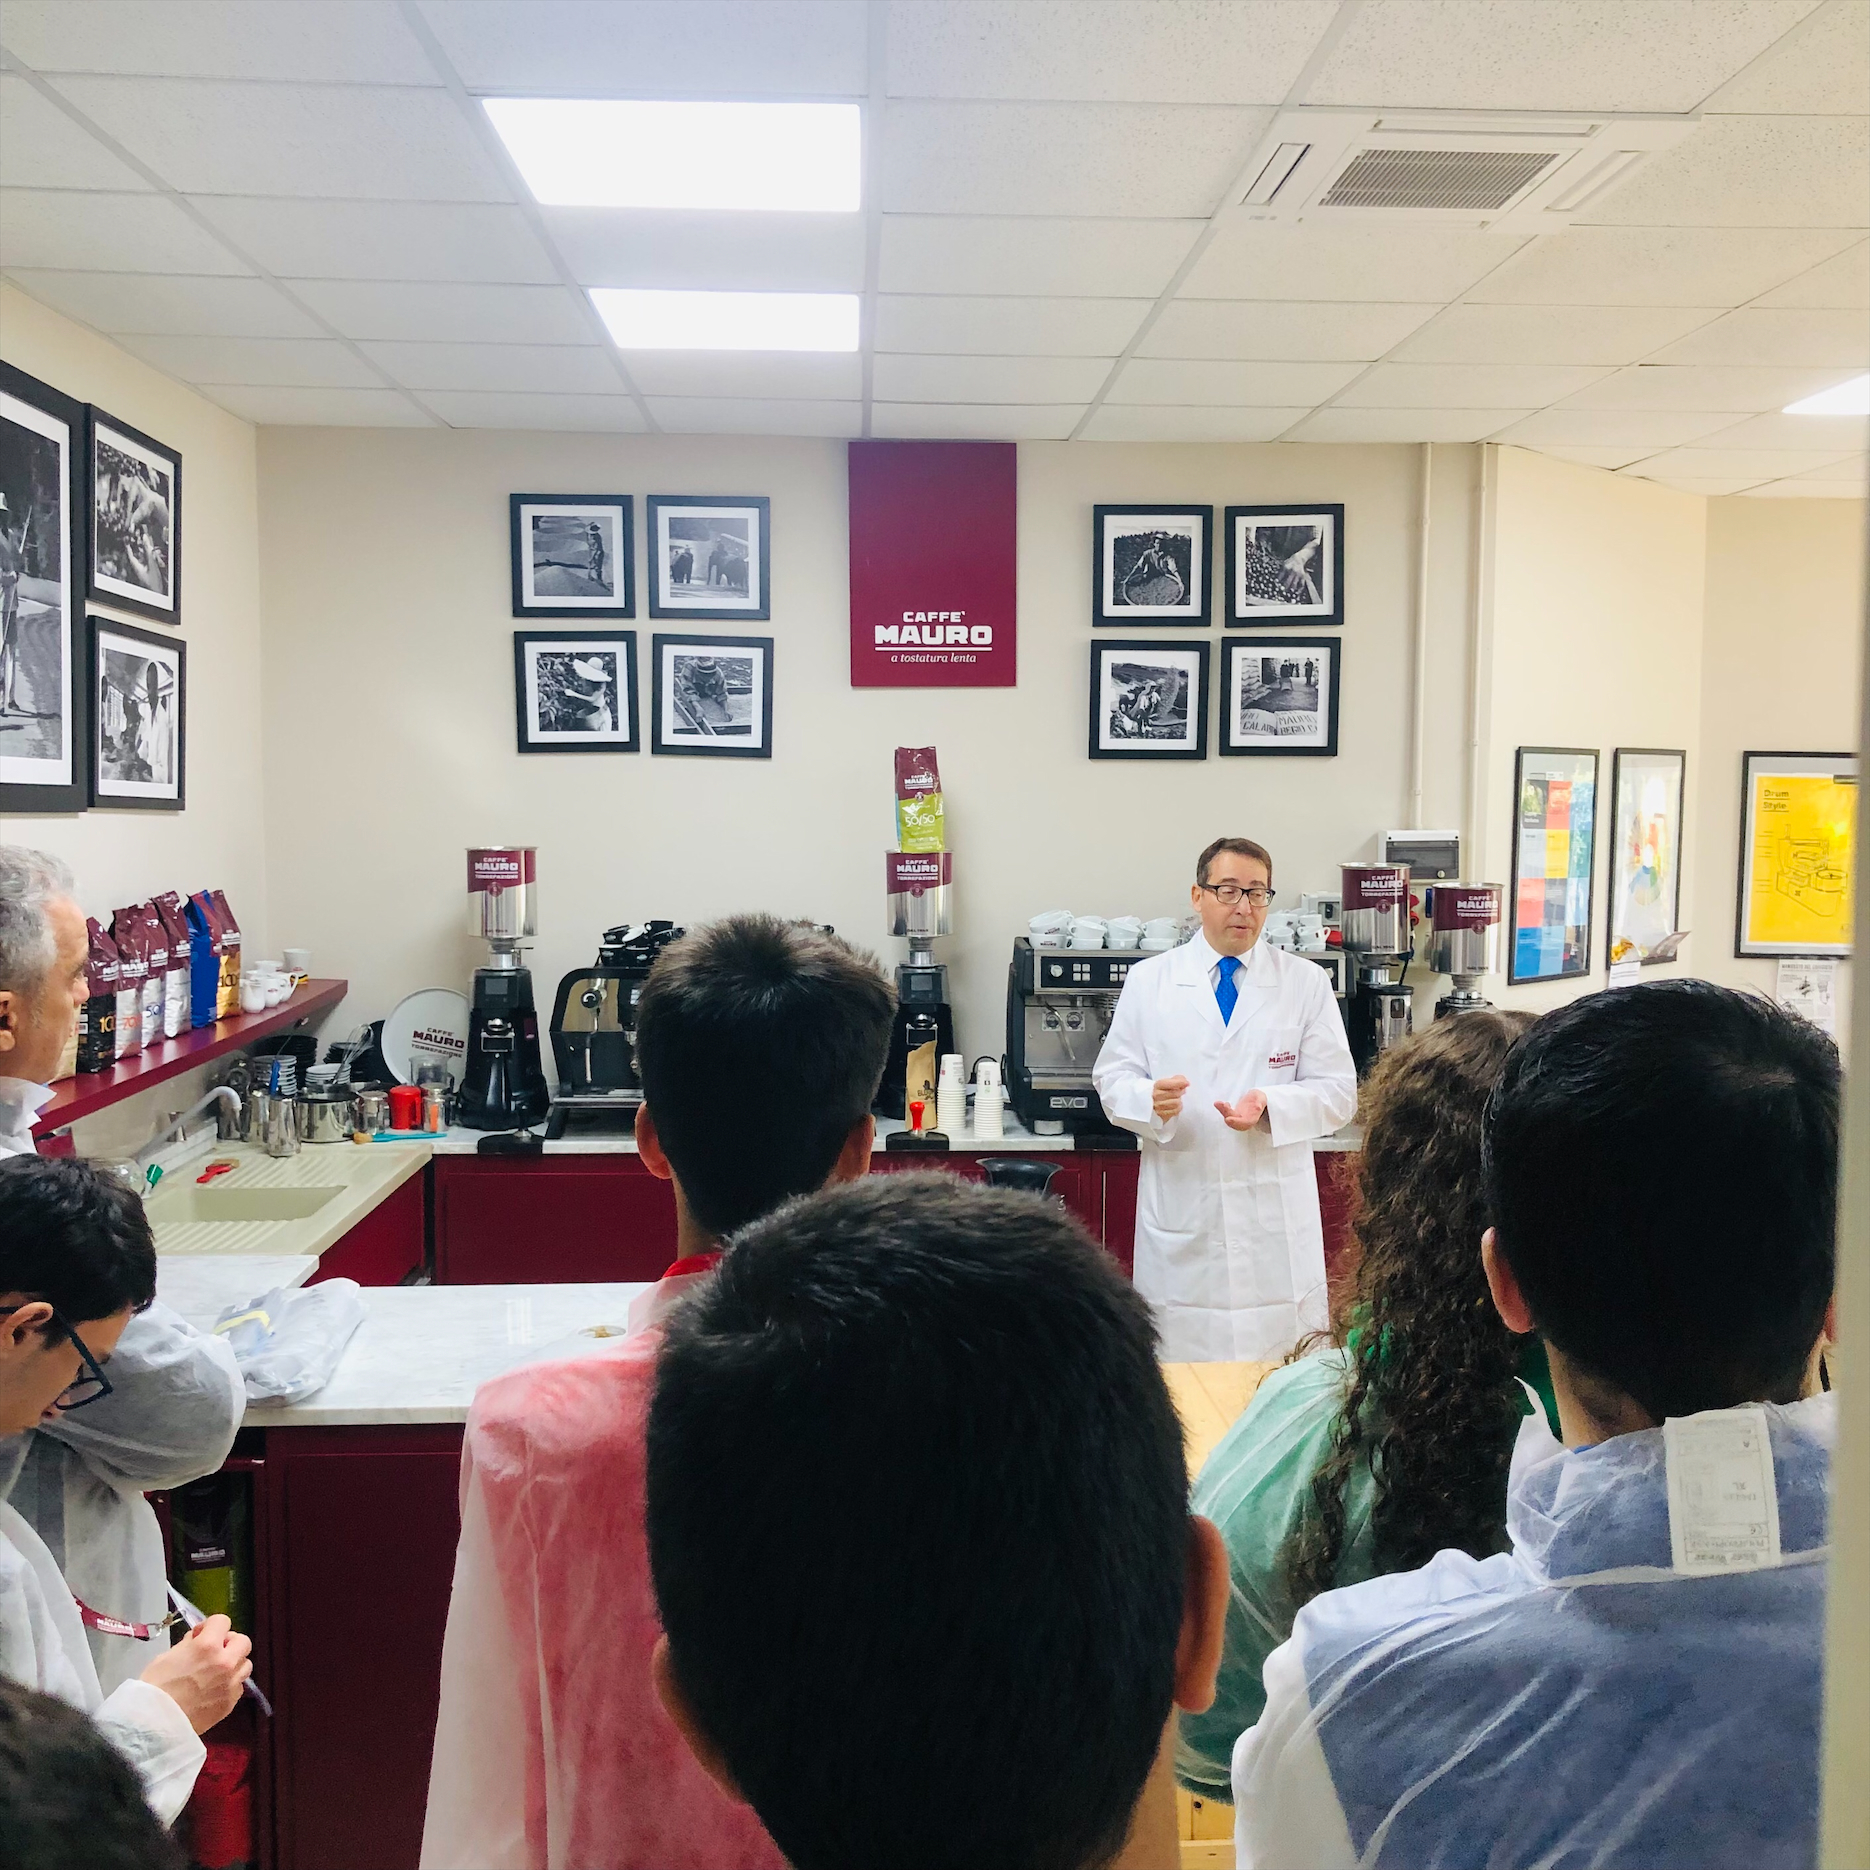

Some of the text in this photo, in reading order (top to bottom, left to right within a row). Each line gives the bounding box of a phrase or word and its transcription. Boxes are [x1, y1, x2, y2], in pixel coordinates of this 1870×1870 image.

[874, 625, 993, 645] MAURO
[890, 652, 977, 663] a tostatura lenta
[1764, 789, 1789, 798] Drum
[1763, 801, 1787, 811] Style
[905, 813, 936, 828] 50/50
[474, 862, 519, 871] MAURO
[896, 864, 939, 873] MAURO
[1360, 880, 1404, 889] MAURO
[1456, 900, 1498, 909] MAURO
[412, 1030, 465, 1049] MAURO
[190, 1549, 226, 1559] MAURO
[97, 1618, 131, 1631] MAURO
